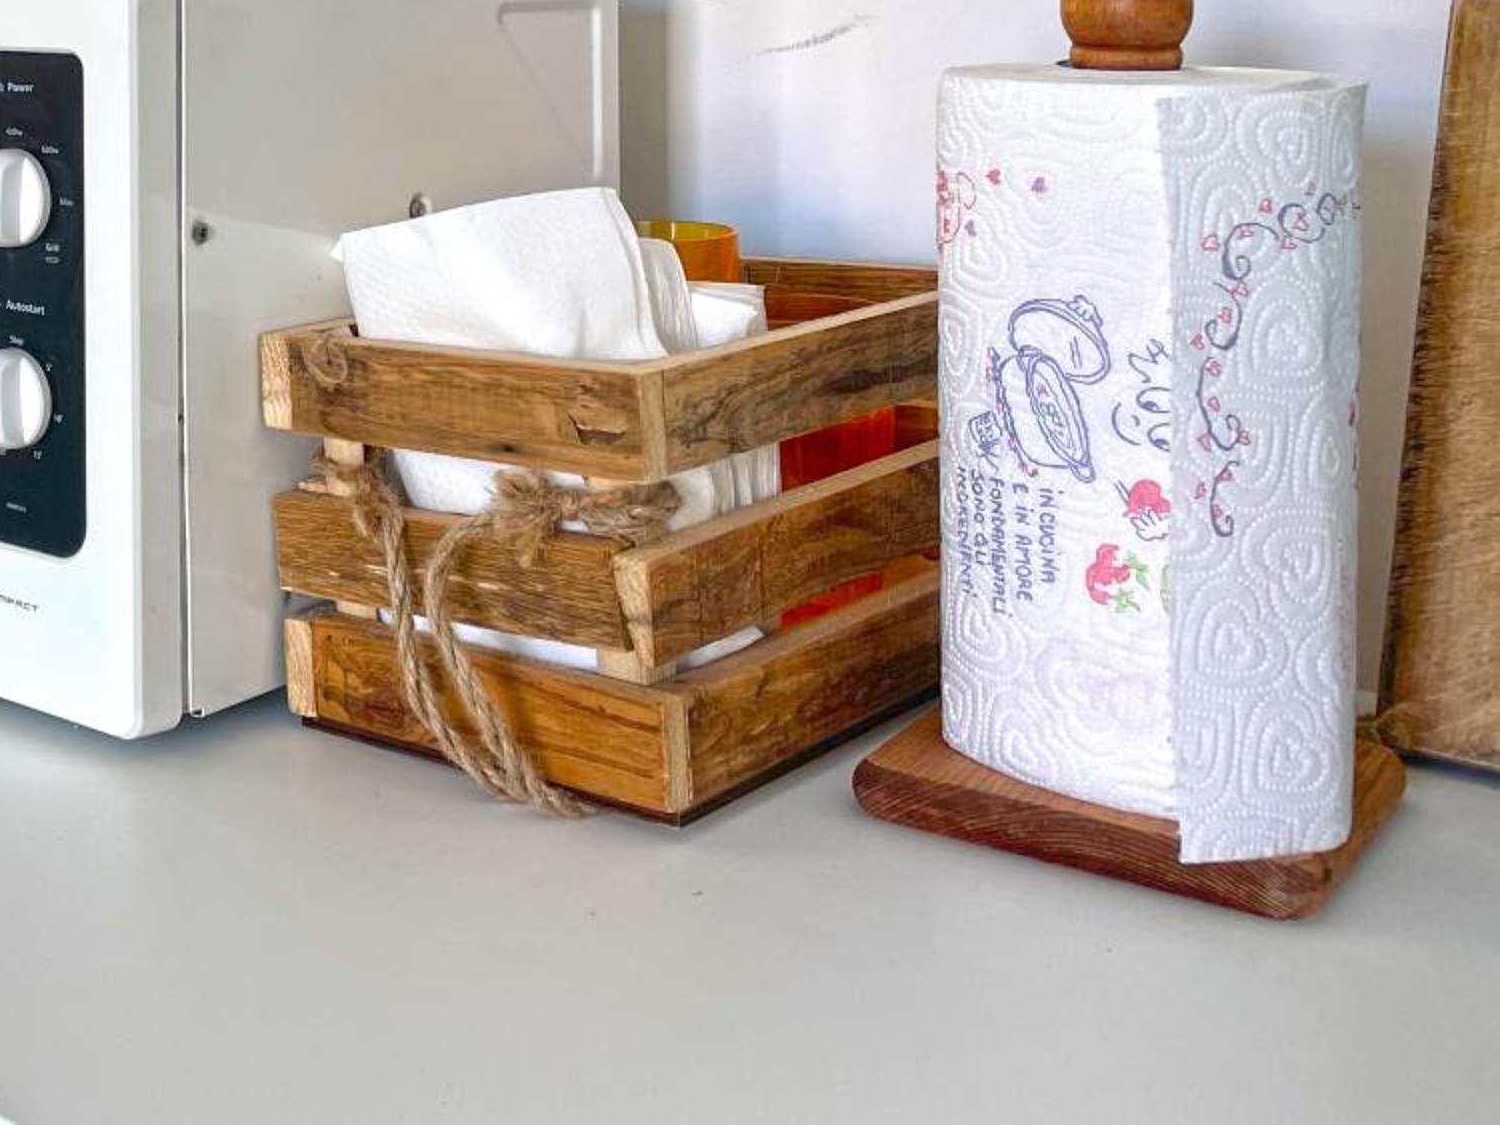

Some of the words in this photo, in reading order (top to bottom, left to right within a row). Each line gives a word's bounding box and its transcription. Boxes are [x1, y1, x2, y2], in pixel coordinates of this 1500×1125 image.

[7, 82, 35, 93] Power
[5, 299, 45, 316] Autostart
[971, 468, 985, 524] SONO
[1012, 482, 1029, 495] E
[1014, 533, 1033, 602] AMORE
